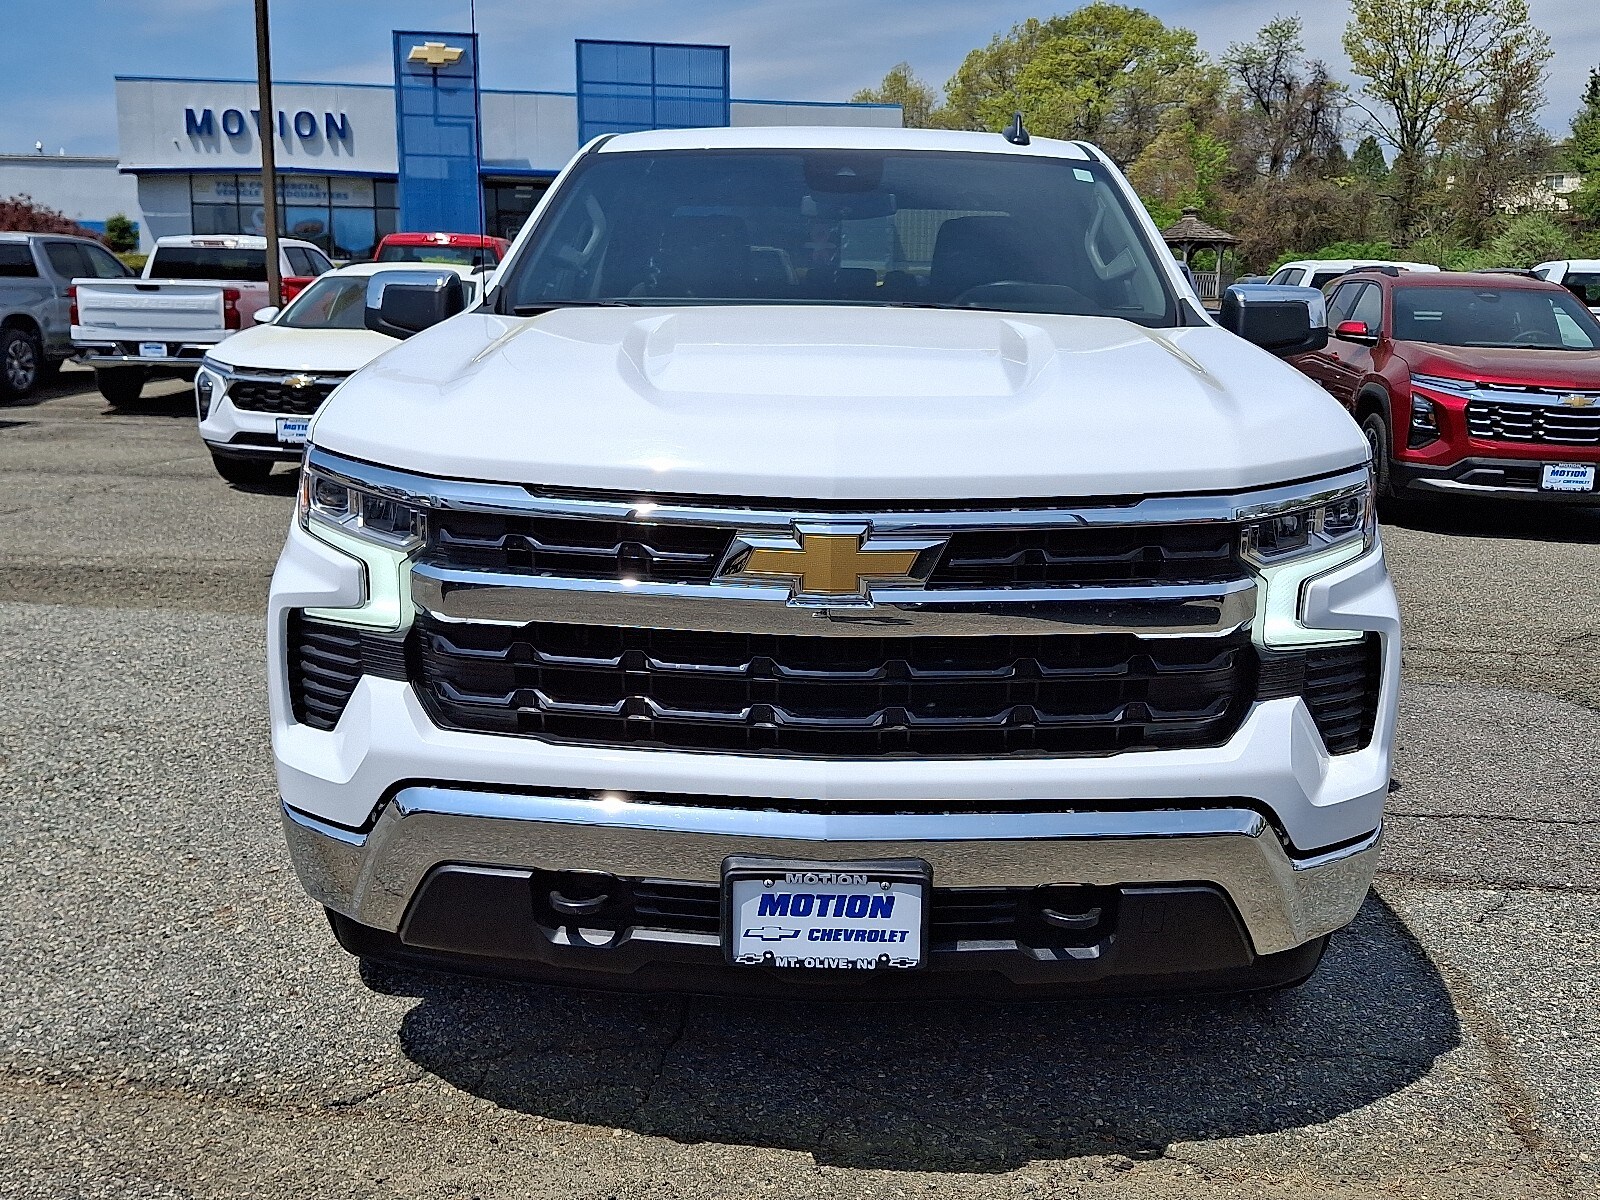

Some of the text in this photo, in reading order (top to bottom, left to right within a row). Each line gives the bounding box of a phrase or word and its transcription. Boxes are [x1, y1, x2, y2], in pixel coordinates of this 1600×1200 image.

[1550, 469, 1587, 477] MOTION
[785, 873, 867, 885] MOTION
[757, 893, 896, 918] MOTION
[807, 928, 910, 943] CHEVROLET
[775, 956, 876, 969] MT. OLIVE, NJ
